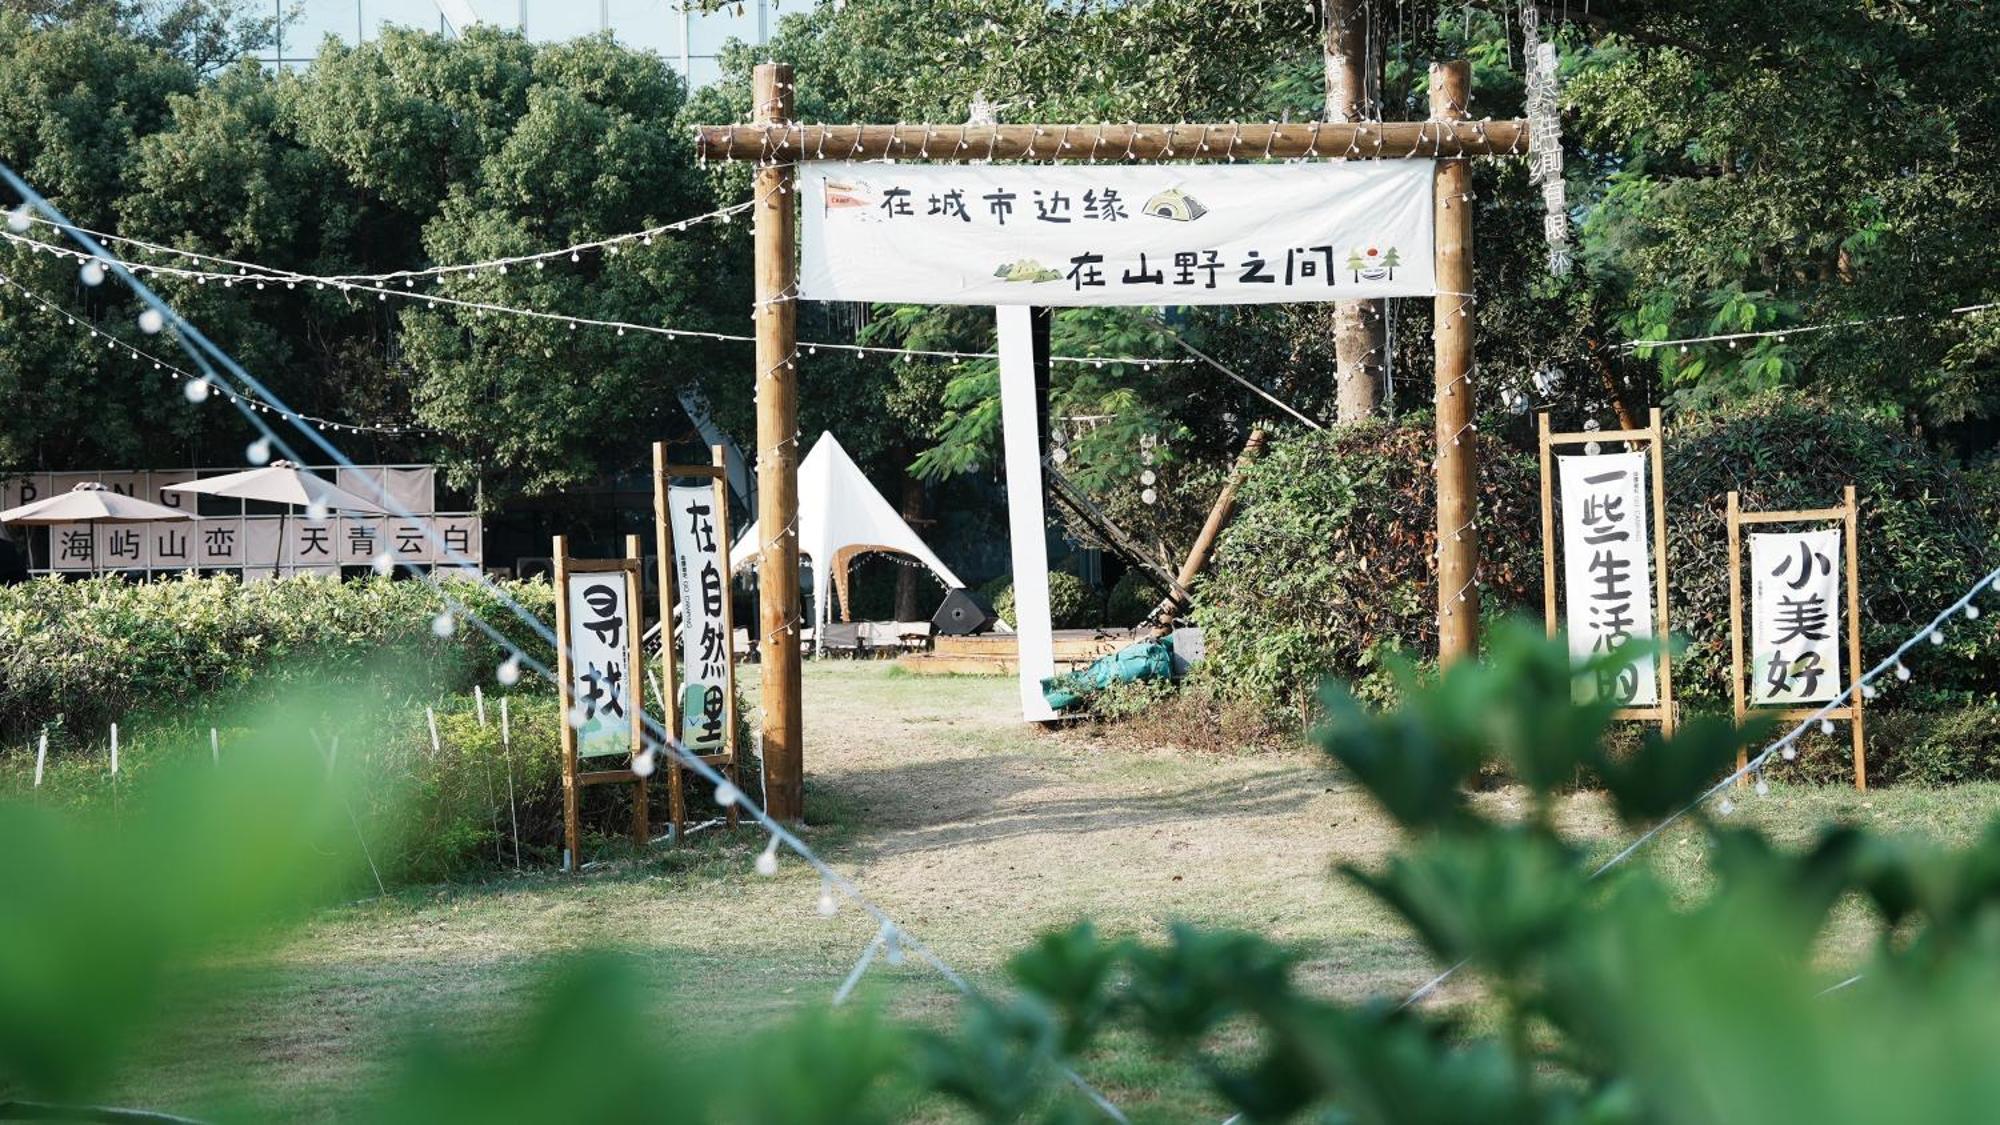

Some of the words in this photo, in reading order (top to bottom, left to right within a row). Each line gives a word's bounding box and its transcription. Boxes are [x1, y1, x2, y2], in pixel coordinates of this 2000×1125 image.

[881, 186, 1129, 225] 在城市边缘
[1066, 245, 1335, 291] 在山野之间
[60, 526, 235, 563] 海屿山峦
[300, 525, 469, 556] 天青云白
[1581, 470, 1639, 705] 一些生活的
[579, 584, 624, 720] 寻找
[686, 498, 727, 743] 在自然里
[1766, 540, 1832, 698] 小美好
